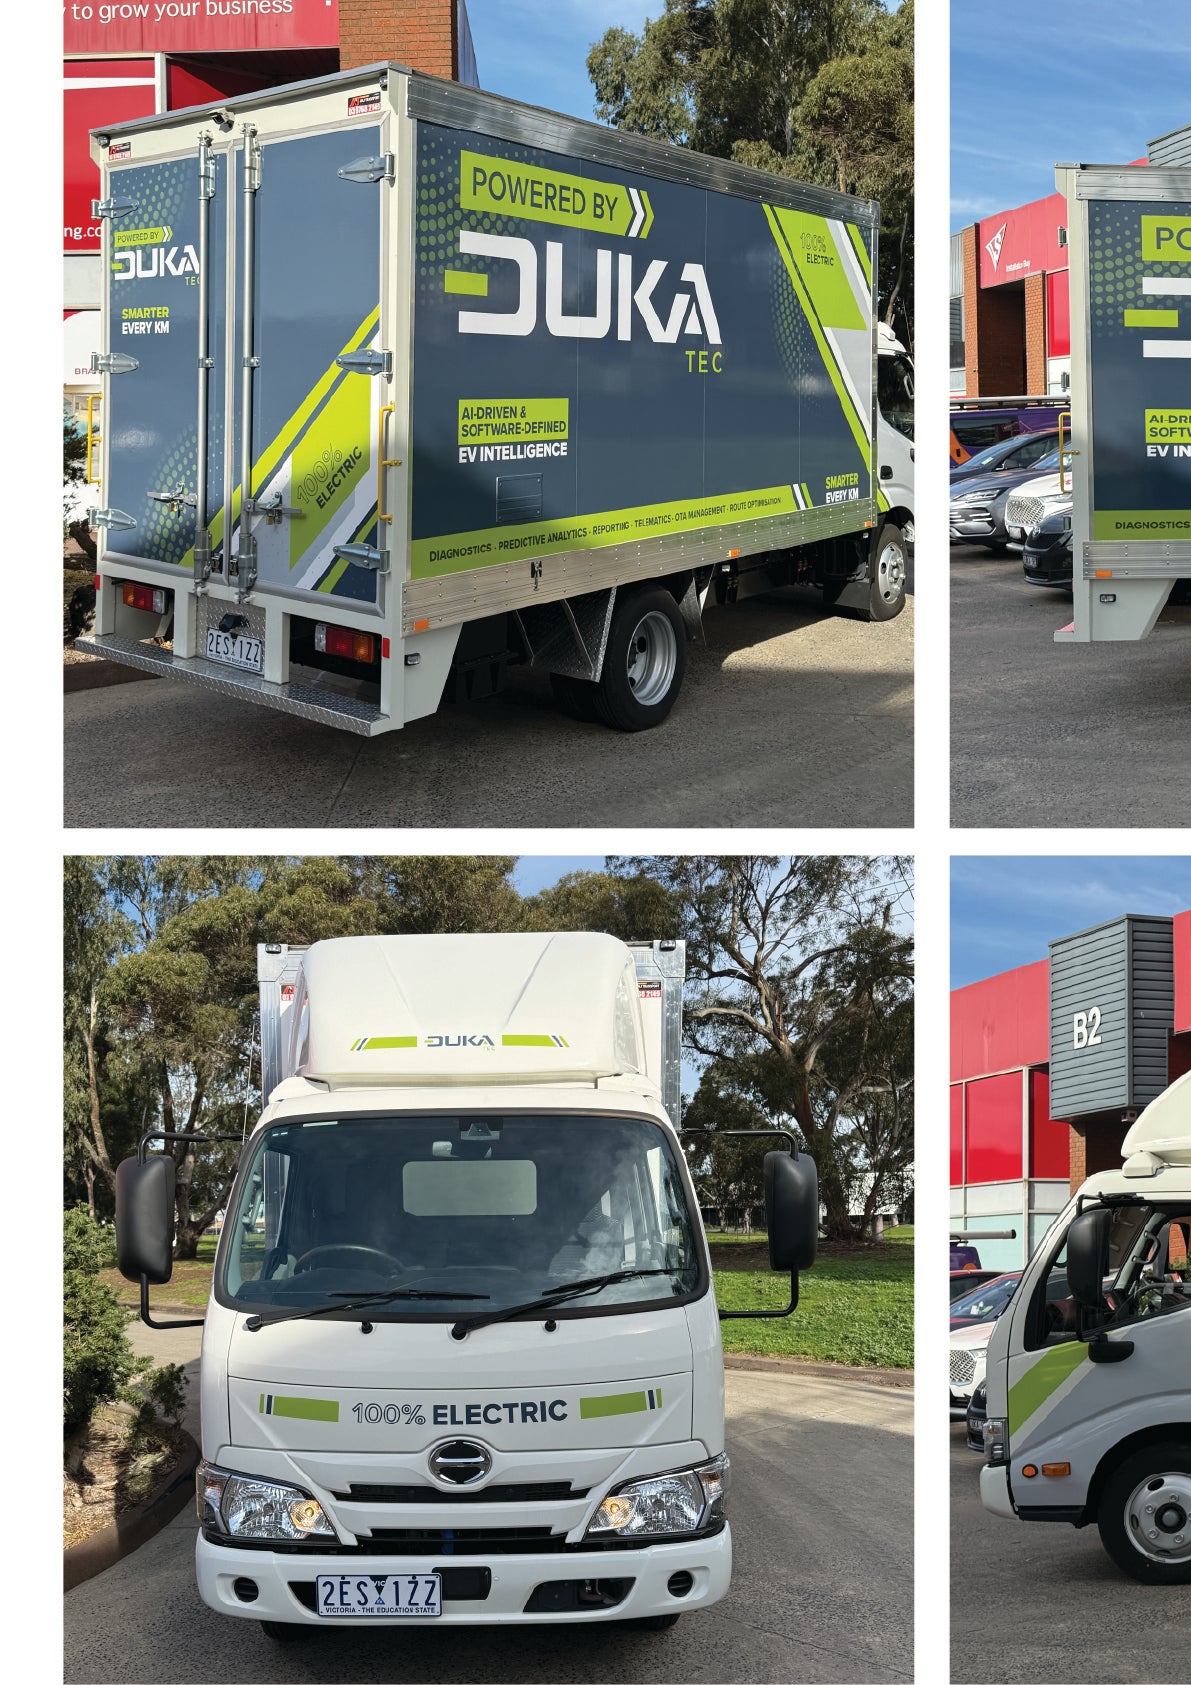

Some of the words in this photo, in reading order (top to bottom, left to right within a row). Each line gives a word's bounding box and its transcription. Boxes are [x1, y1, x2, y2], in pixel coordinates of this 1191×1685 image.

[72, 5, 92, 20] to
[99, 4, 149, 24] grow
[154, 2, 200, 22] your
[206, 0, 293, 16] business
[472, 166, 586, 216] POWERED
[593, 192, 618, 222] BY
[117, 232, 149, 243] POWERED
[150, 231, 160, 240] BY
[112, 244, 200, 280] DUKA
[806, 253, 834, 266] ELECTRIC
[444, 229, 722, 345] DUKA
[122, 306, 170, 320] SMARTER
[122, 321, 152, 335] EVERY
[154, 320, 170, 334] KM
[685, 350, 722, 373] TEC
[462, 406, 518, 420] AI-DRIVEN
[520, 406, 526, 418] &
[462, 420, 566, 438] SOFTWARE-DEFINED
[458, 446, 478, 464] EV
[480, 442, 568, 462] INTELLIGENCE
[1146, 445, 1170, 458] EV
[297, 442, 342, 504] 100%
[315, 446, 362, 510] ELECTRIC
[826, 472, 858, 490] SMARTER
[826, 490, 847, 504] EVERY
[848, 488, 858, 500] KM
[430, 543, 492, 562] DIAGNOSTICS
[498, 534, 546, 550] PREDICTIVE
[548, 528, 588, 543] ANALYTICS
[592, 520, 630, 535] REPORTING
[634, 514, 672, 528] TELEMATICS
[675, 511, 687, 522] OTA
[688, 506, 726, 520] MANAGEMENT
[730, 502, 747, 512] ROUTE
[748, 497, 782, 509] OPTIMISATION
[1115, 521, 1190, 529] DIAGNOSTICS
[1074, 1006, 1102, 1050] B2
[424, 1034, 494, 1048] DUKA
[352, 1402, 426, 1425] 100%
[432, 1400, 568, 1425] ELECTRIC
